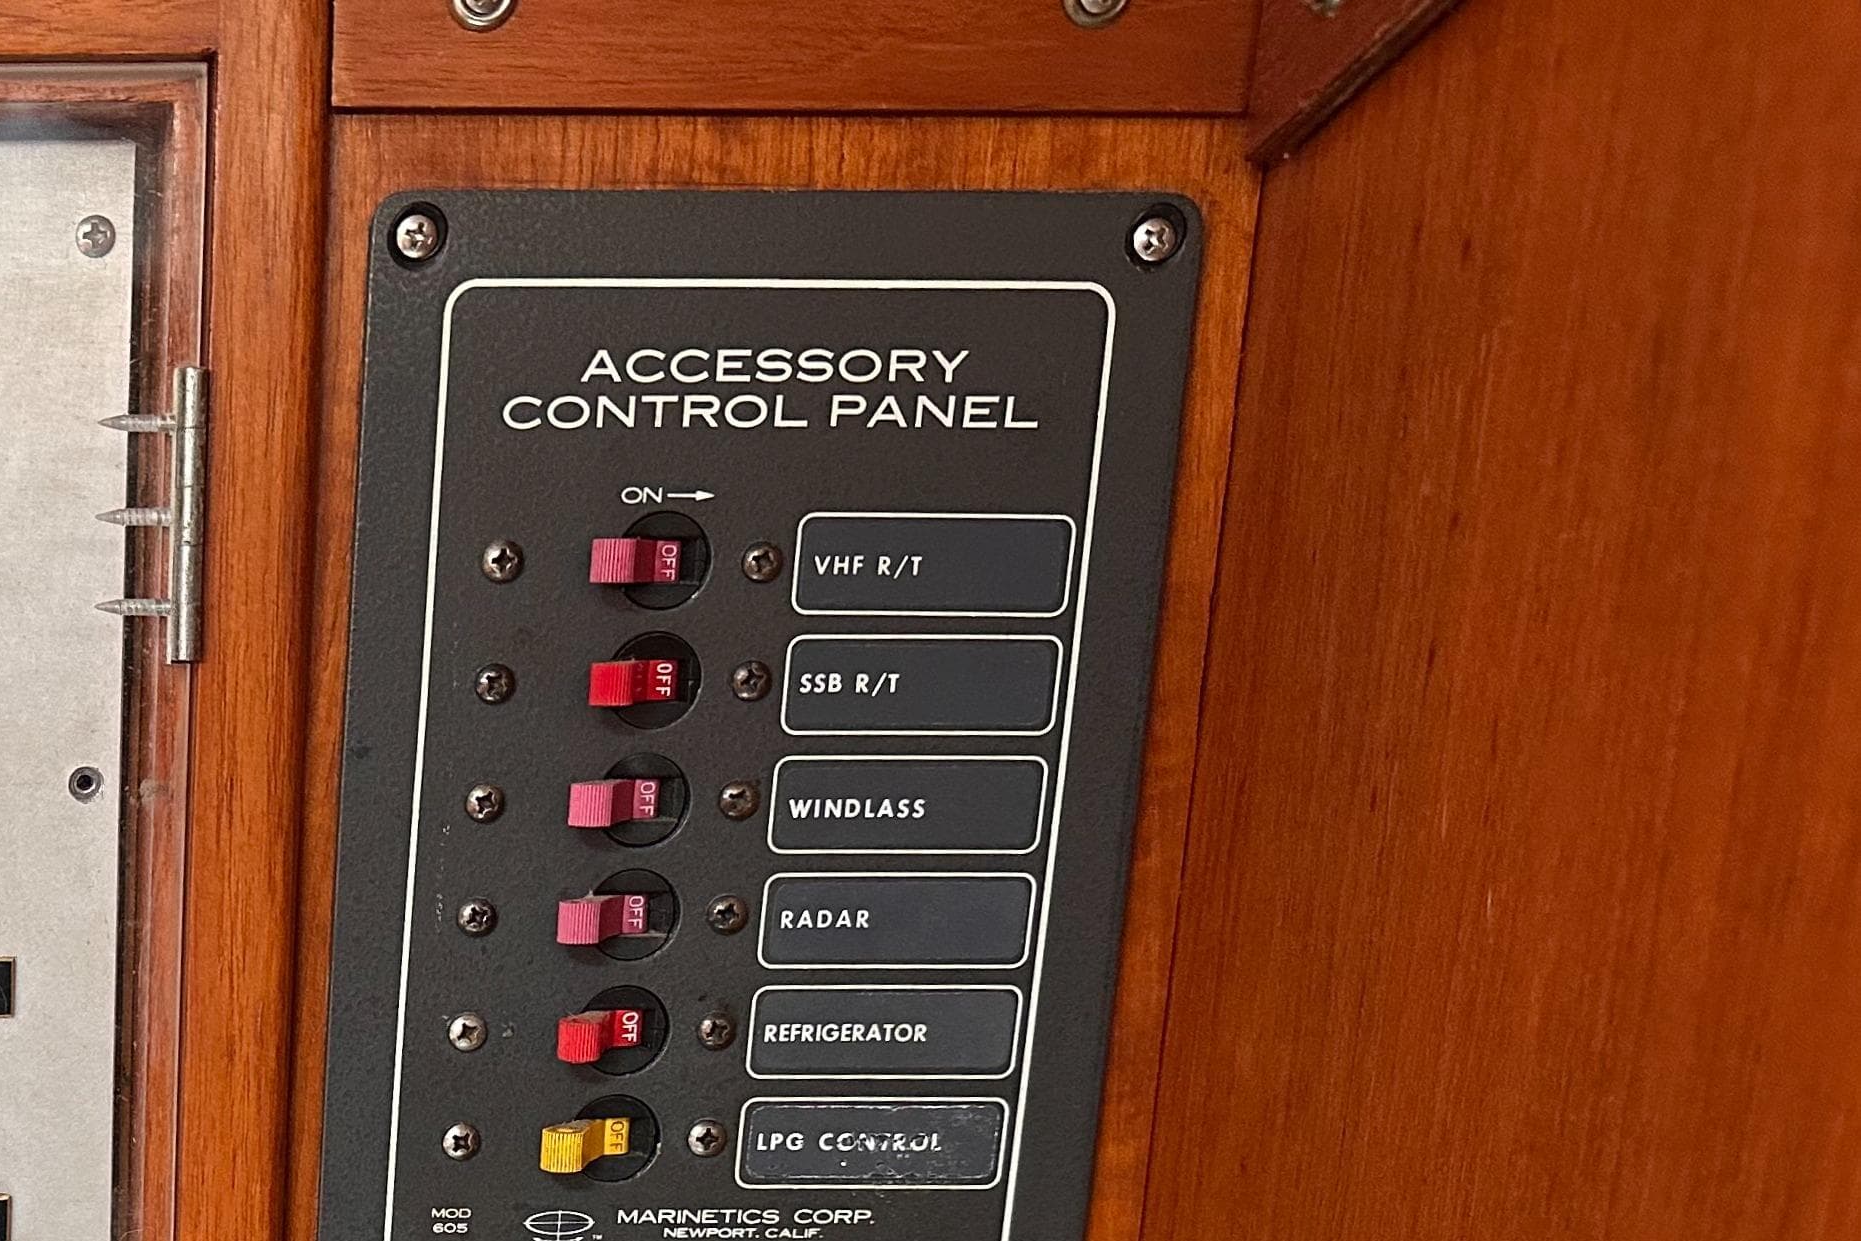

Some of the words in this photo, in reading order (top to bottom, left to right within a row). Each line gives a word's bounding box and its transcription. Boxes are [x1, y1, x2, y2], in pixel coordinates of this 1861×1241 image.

[580, 347, 970, 383] ACCESSORY
[502, 395, 808, 430] CONTROL
[829, 395, 1039, 430] PANEL
[621, 487, 663, 504] ON
[661, 544, 678, 581] OFF
[814, 554, 865, 576] VHF
[877, 552, 924, 579] R/T
[655, 662, 673, 697] OFF
[799, 672, 843, 694] SSB
[855, 670, 901, 697] R/T
[639, 781, 656, 817] OFF
[788, 798, 927, 821] WINDLASS
[627, 895, 644, 930] OFF
[779, 908, 871, 930] RADAR
[621, 1011, 639, 1043] OFF
[763, 1022, 928, 1045] REFRIGERATOR
[609, 1120, 625, 1153] OFF
[757, 1132, 804, 1151] LPG
[818, 1132, 942, 1151] CONTROL
[431, 1207, 472, 1219] MOD
[616, 1209, 780, 1225] MARINETICS
[793, 1209, 875, 1225] CORP.
[432, 1223, 468, 1235] 605
[764, 1227, 824, 1239] CALIF.
